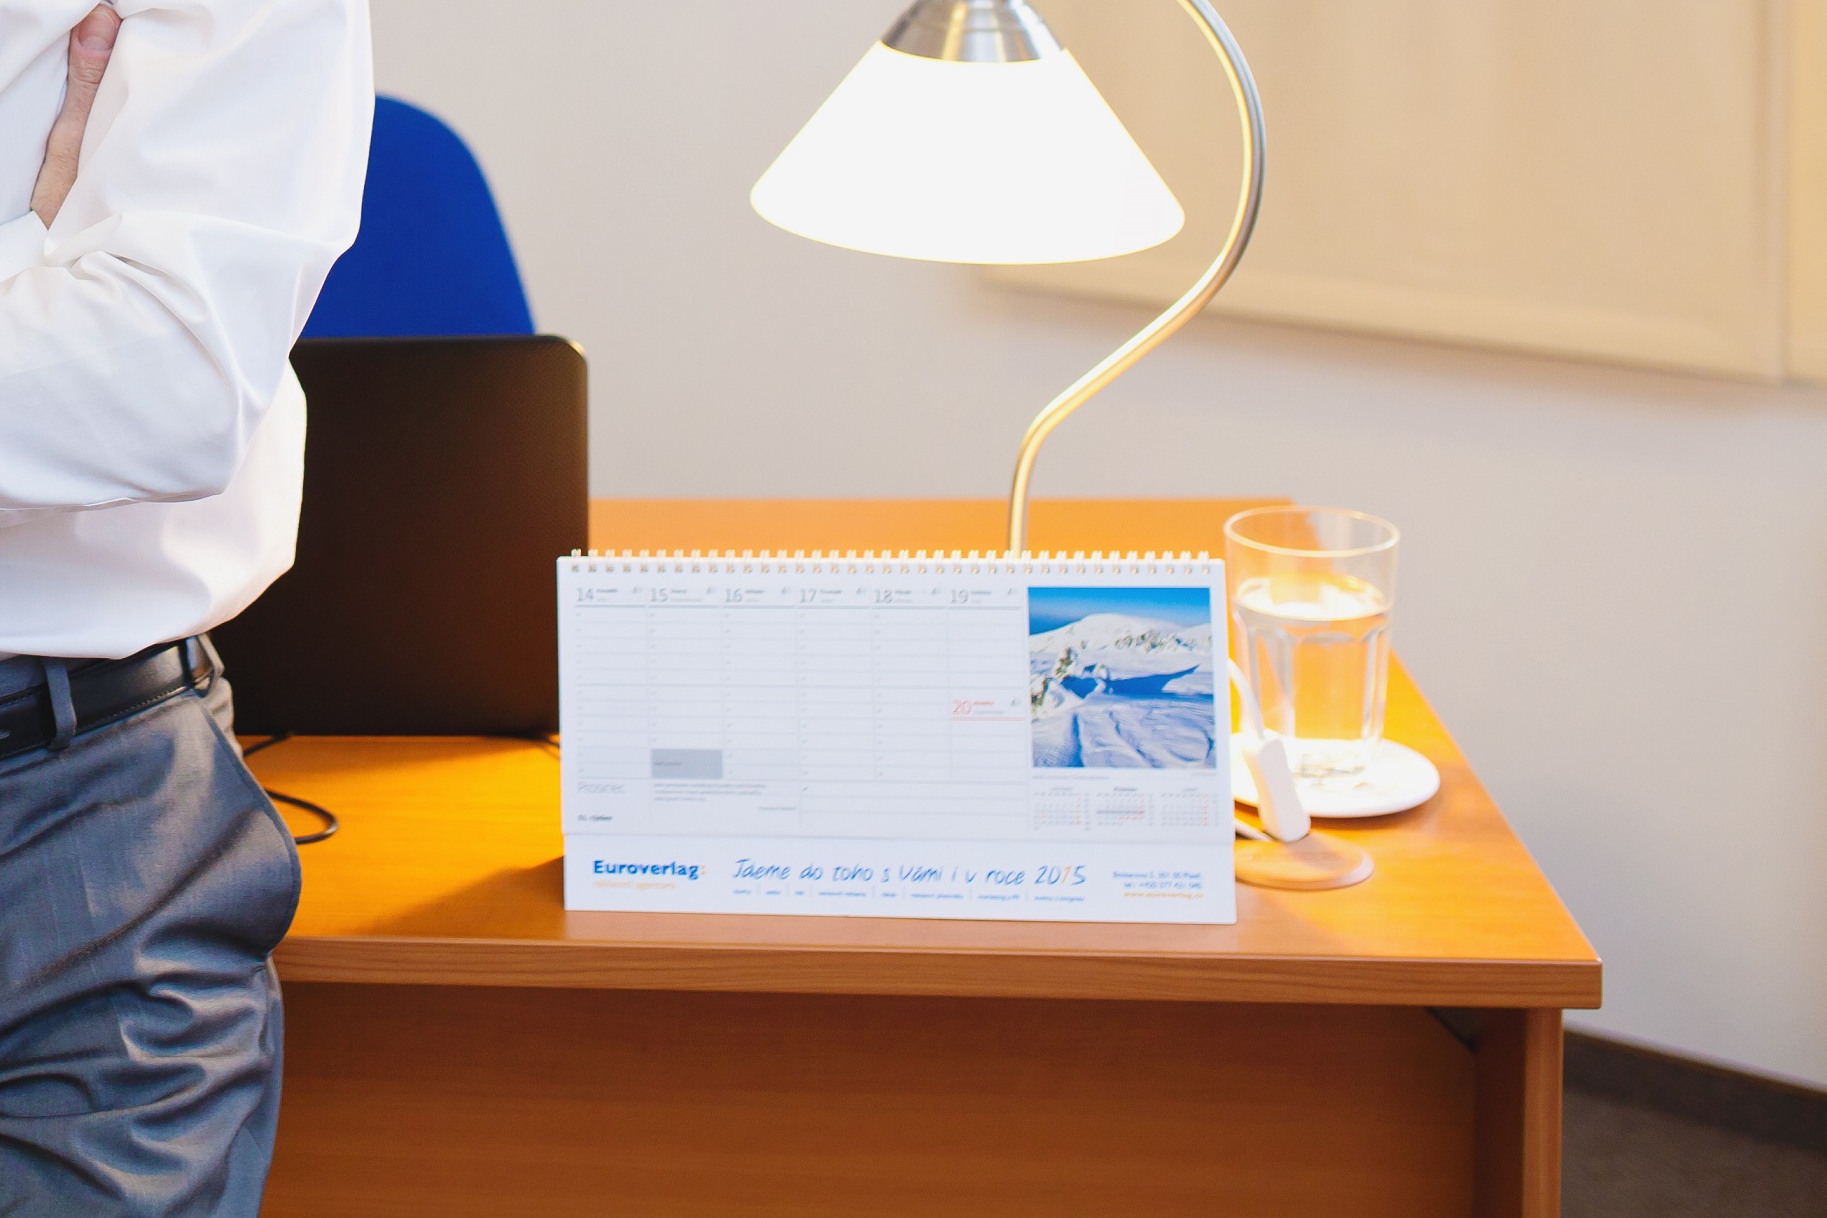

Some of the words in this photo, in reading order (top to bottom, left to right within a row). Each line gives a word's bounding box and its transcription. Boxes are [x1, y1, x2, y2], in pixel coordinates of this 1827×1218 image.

[724, 587, 743, 603] 16
[799, 588, 818, 603] 17
[952, 699, 973, 716] 20
[799, 862, 824, 880] do
[831, 863, 874, 882] toho
[985, 868, 1025, 885] roce
[1033, 864, 1087, 886] 2015
